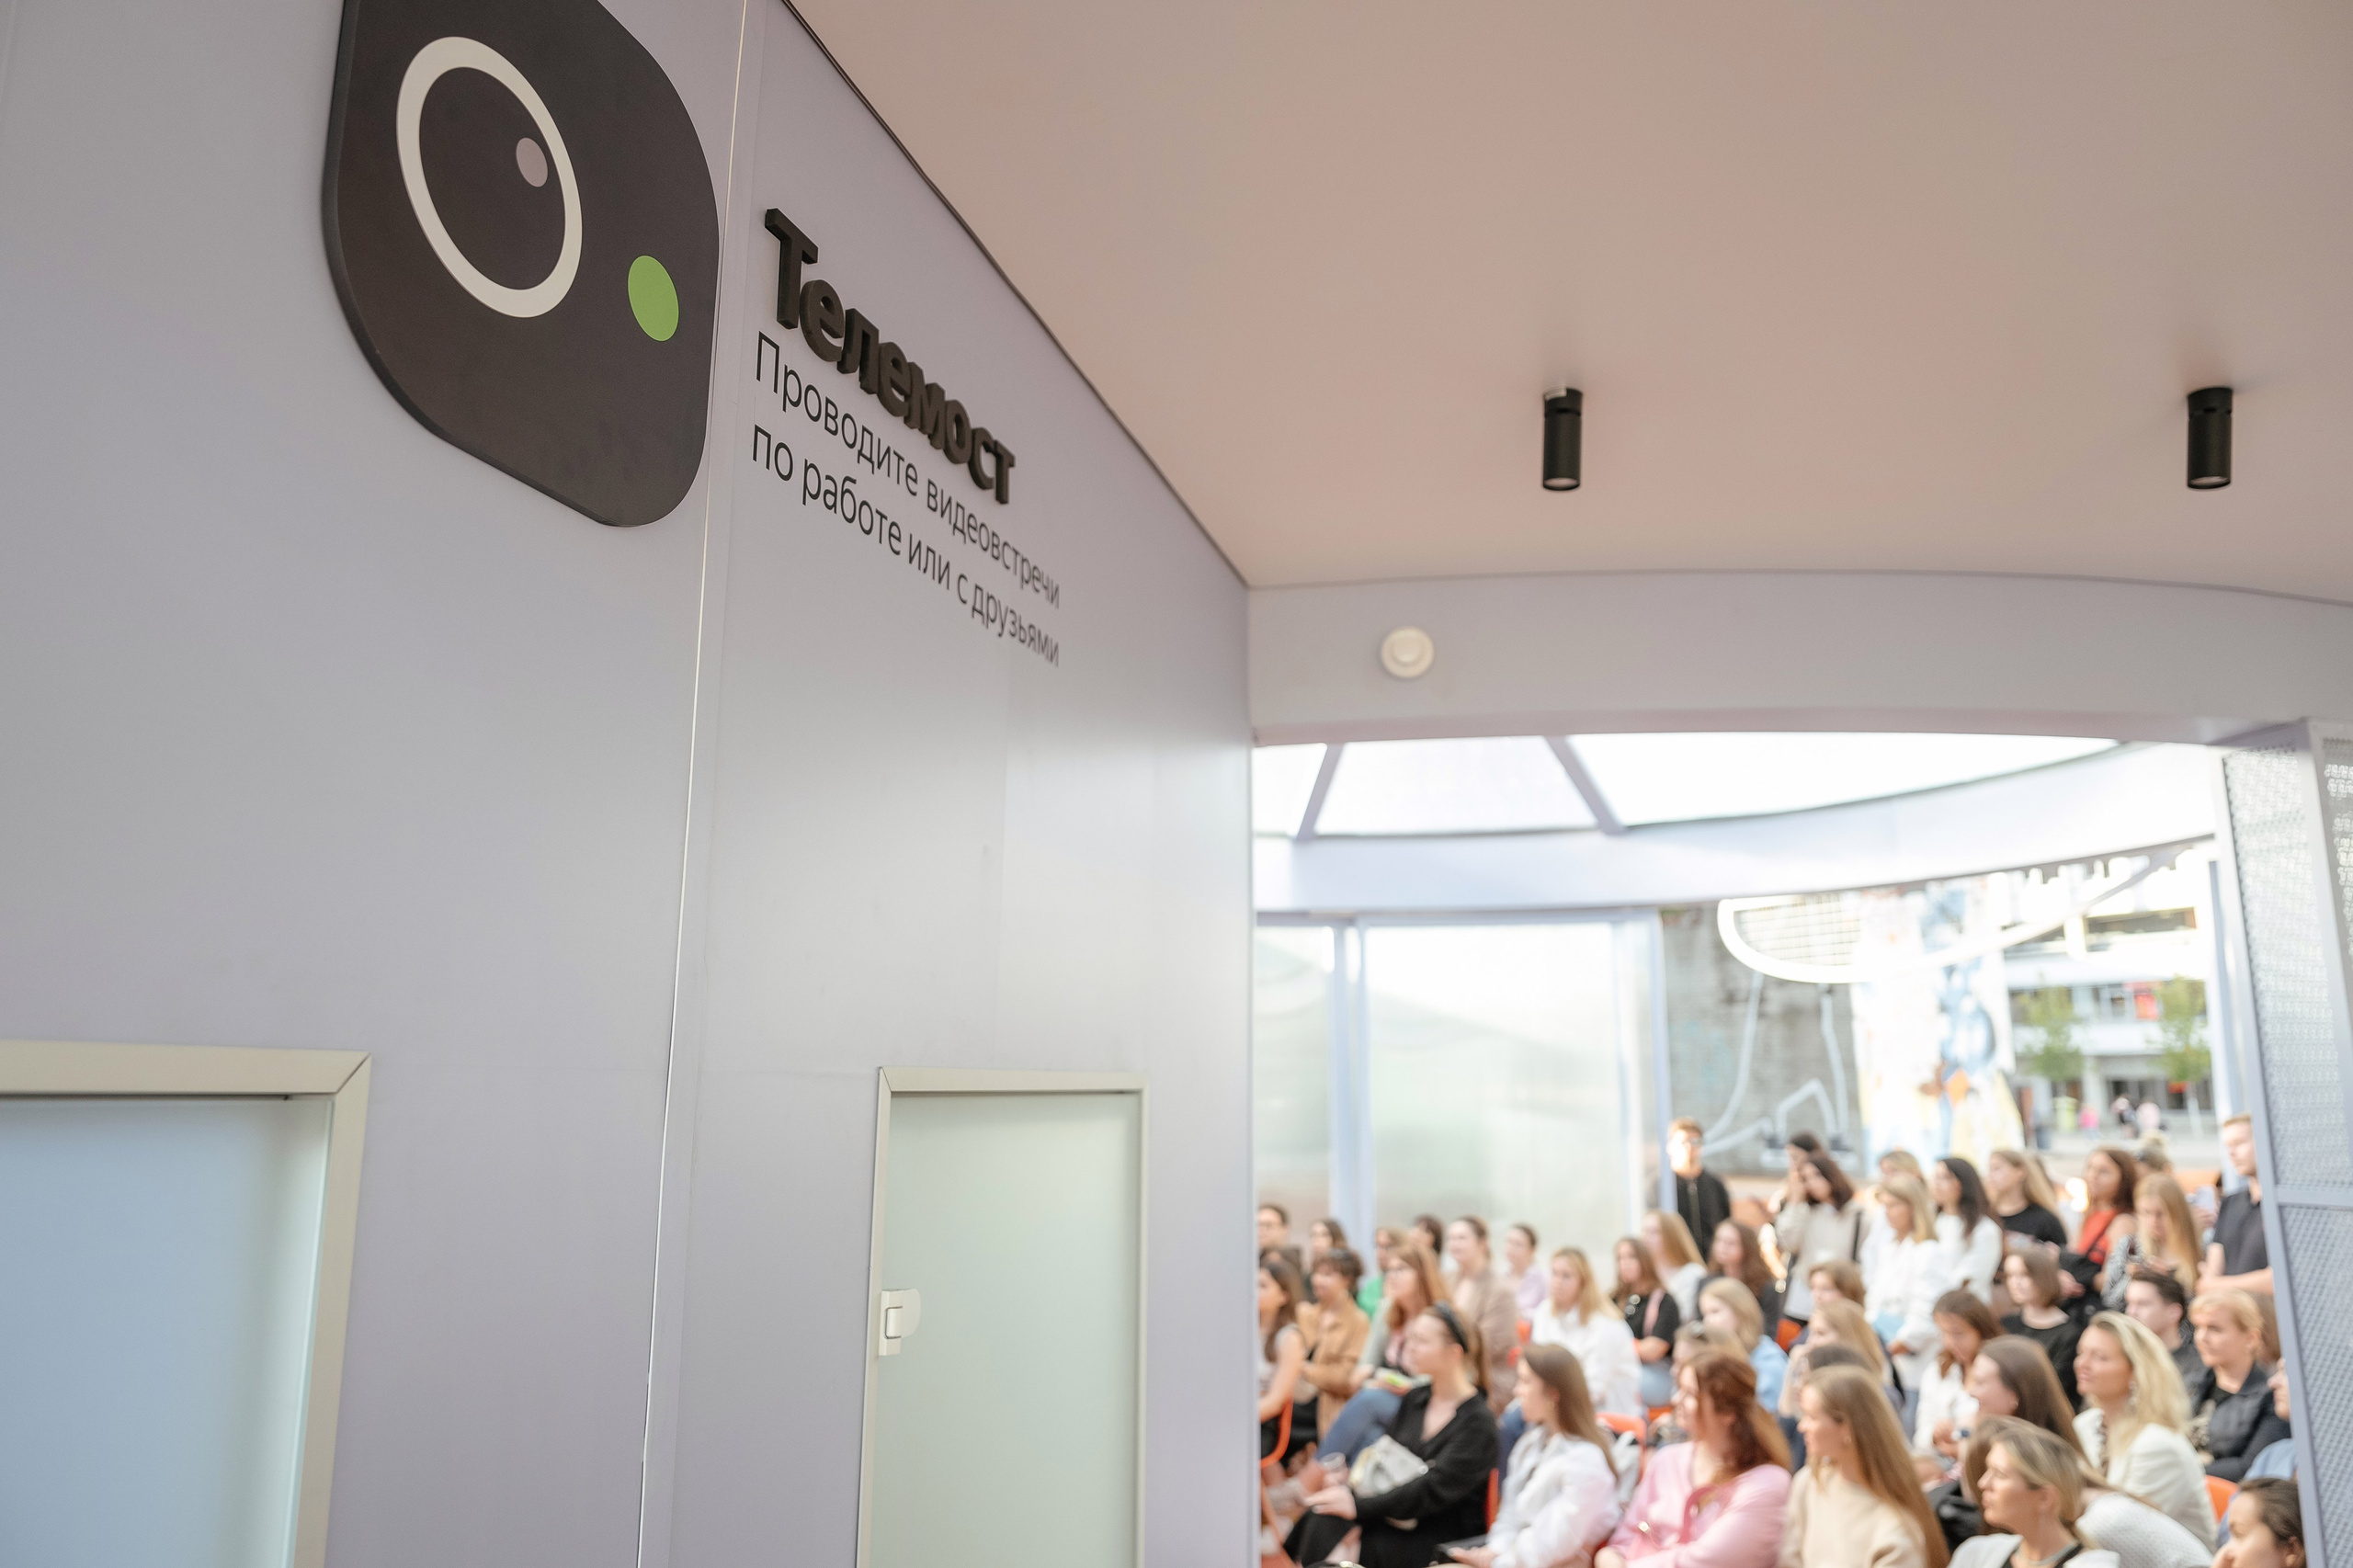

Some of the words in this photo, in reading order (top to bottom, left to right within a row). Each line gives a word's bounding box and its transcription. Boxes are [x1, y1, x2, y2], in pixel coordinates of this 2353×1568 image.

[756, 331, 917, 496] Проводите
[927, 478, 1060, 609] видеовстречи
[765, 208, 1016, 505] Телемост
[753, 424, 793, 482] по
[802, 458, 902, 555] работе
[908, 533, 950, 590] или
[957, 573, 968, 606] с
[972, 585, 1060, 667] друзьями
